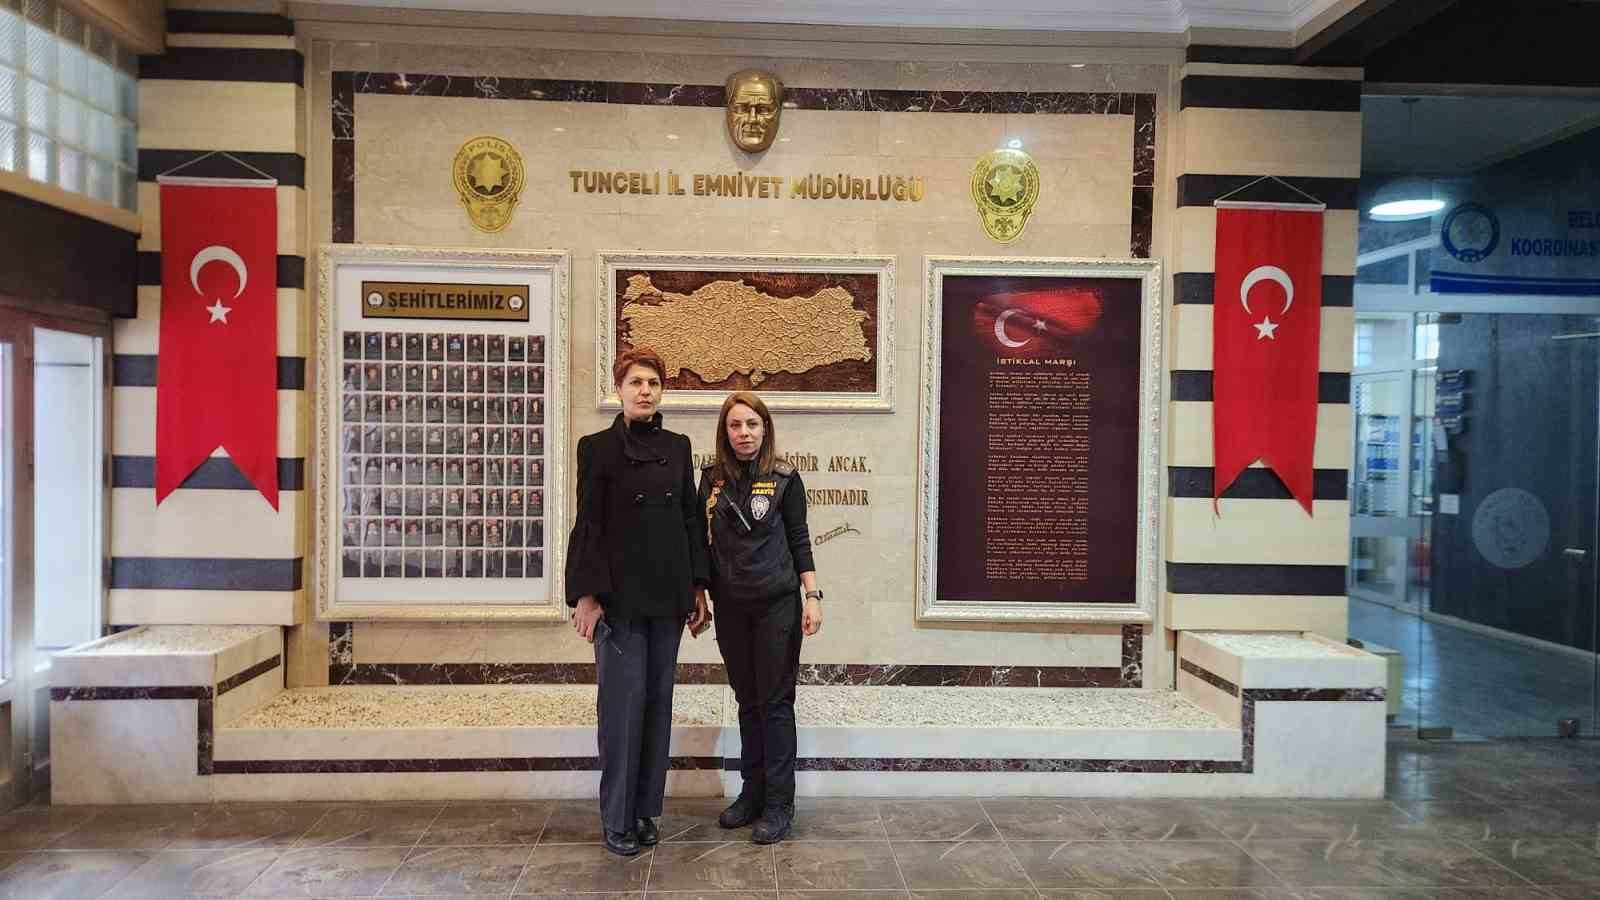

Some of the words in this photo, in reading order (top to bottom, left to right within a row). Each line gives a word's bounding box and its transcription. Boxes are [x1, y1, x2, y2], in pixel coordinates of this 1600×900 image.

[569, 170, 660, 195] TUNCELİ
[667, 169, 686, 195] İL
[693, 171, 784, 199] EMNİYET
[791, 173, 925, 202] MÜDÜRLÜĞÜ
[388, 288, 505, 313] ŞEHİTLERİMİZ
[996, 357, 1041, 366] İSTİKLAL
[1044, 359, 1077, 368] MARŞI
[784, 451, 819, 472] İSİDİR
[806, 488, 869, 508] ŞISINDADIR
